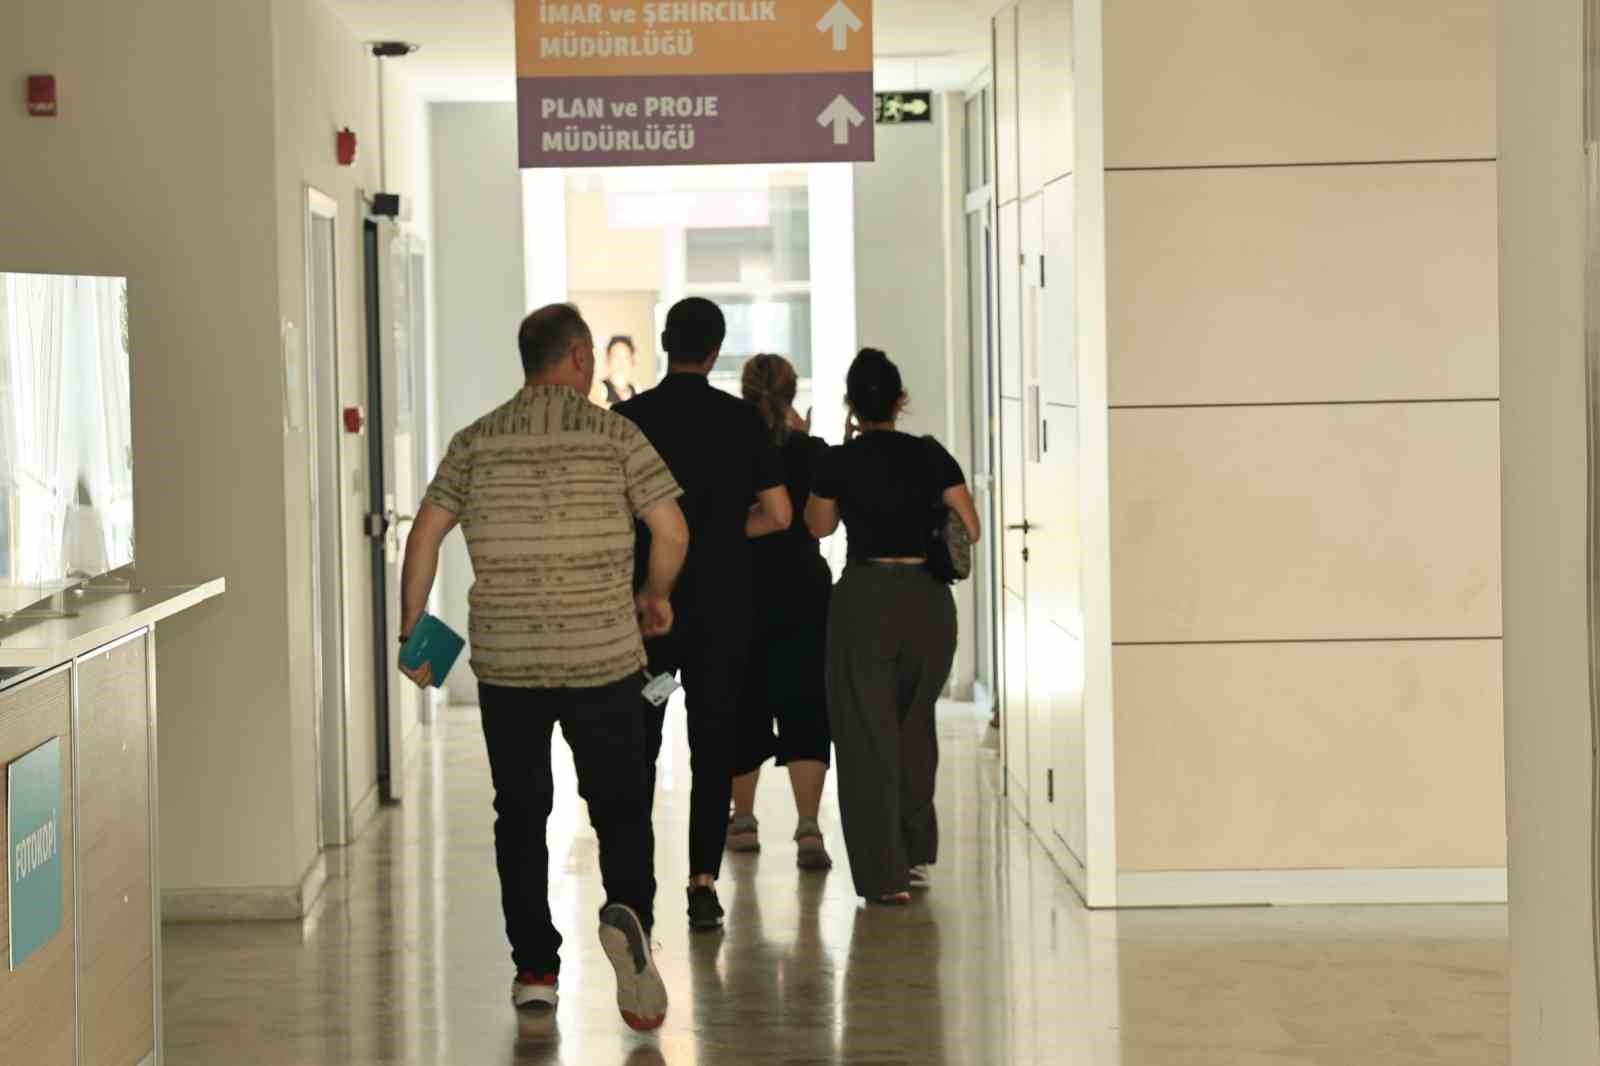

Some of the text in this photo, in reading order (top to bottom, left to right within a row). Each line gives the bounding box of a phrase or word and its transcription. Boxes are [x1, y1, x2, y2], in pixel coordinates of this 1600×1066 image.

[540, 0, 602, 24] İMAR
[608, 7, 636, 23] ve
[540, 30, 695, 57] MÜDÜRLÜĞÜ
[541, 96, 718, 118] PLAN ve PROJE
[542, 123, 695, 152] MÜDÜRLÜĞÜ
[15, 807, 57, 883] FOTOKOPİ
